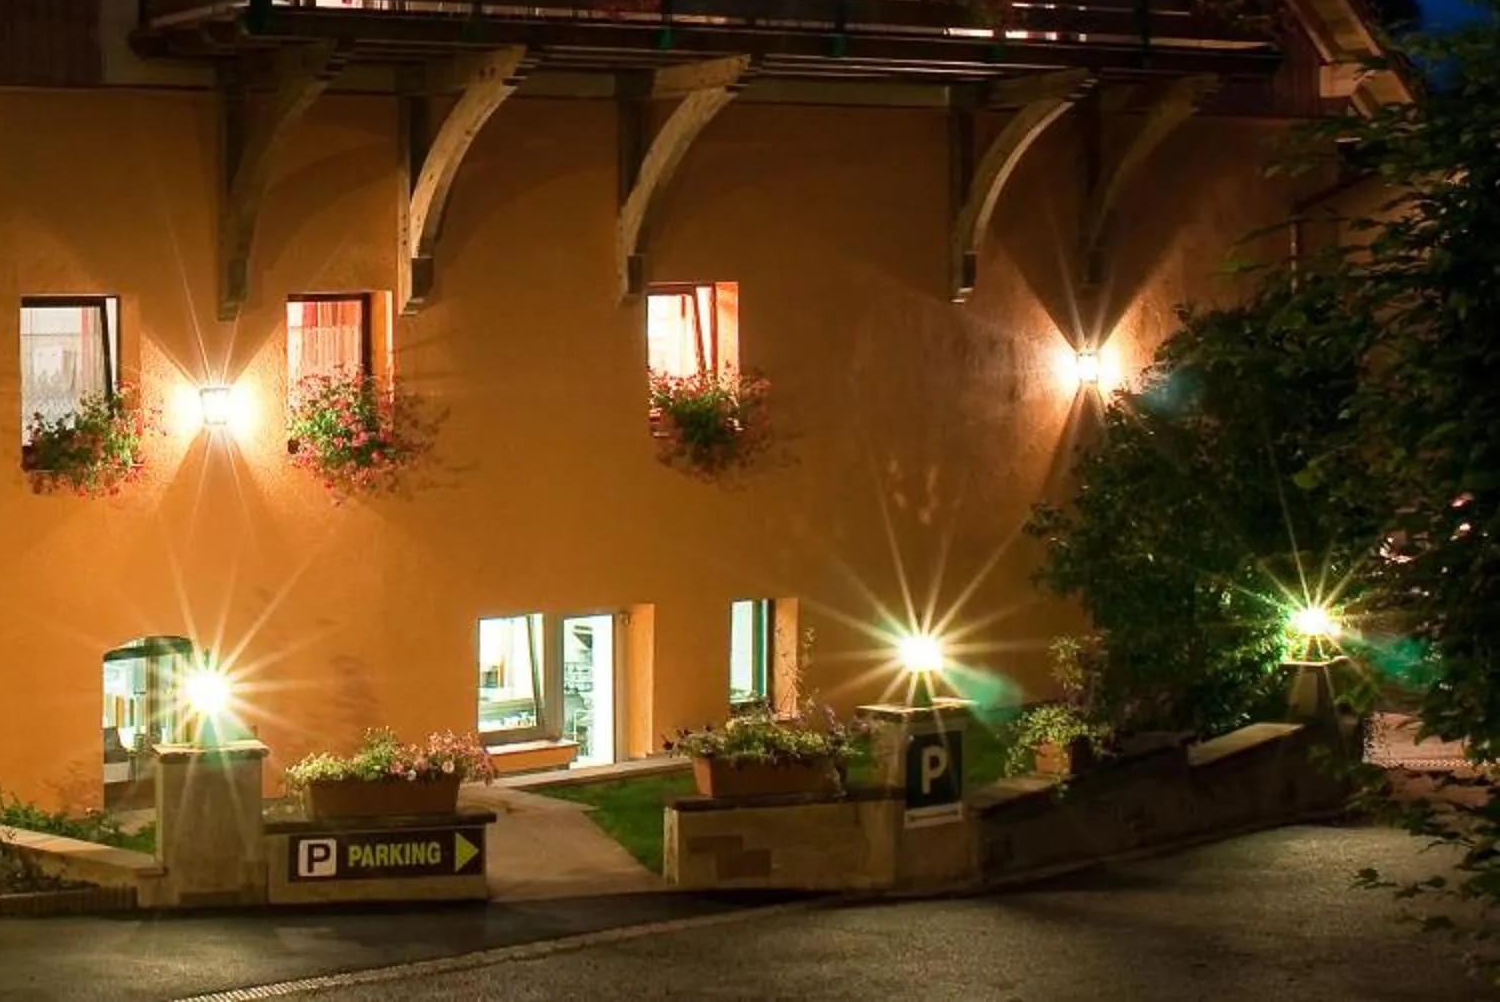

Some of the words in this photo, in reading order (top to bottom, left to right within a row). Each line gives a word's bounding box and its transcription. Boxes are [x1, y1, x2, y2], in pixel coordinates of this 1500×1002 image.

[921, 745, 948, 794] P
[307, 843, 331, 873] P
[347, 842, 441, 867] PARKING
